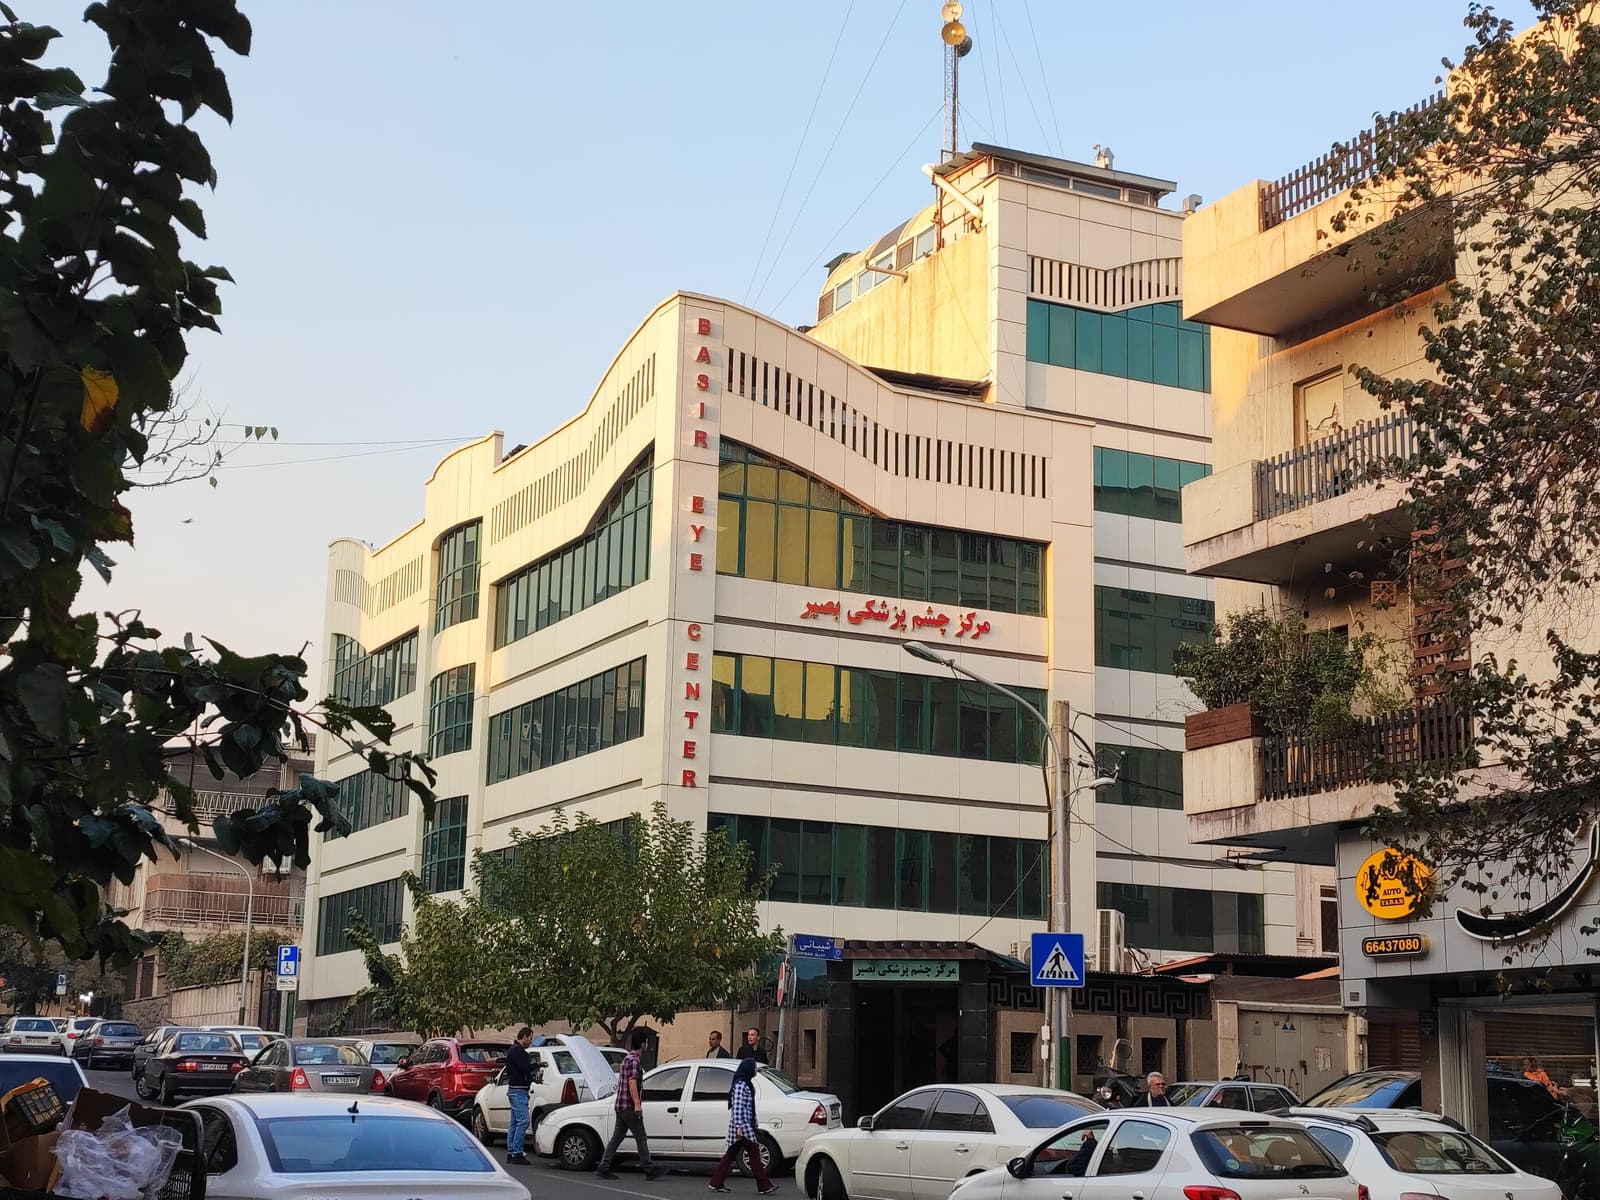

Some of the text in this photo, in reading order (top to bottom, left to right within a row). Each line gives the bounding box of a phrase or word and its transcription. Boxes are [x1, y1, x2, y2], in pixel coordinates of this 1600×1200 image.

[682, 317, 711, 788] BASIR EYE CENTER
[800, 599, 991, 640] مرکز چشم پزشکی بصیر
[1383, 888, 1402, 896] AUTO
[799, 940, 831, 952] شیبانی
[1365, 938, 1420, 953] 66437080
[281, 947, 291, 961] P
[855, 963, 957, 978] مرکز چشم پزشکی بصیر
